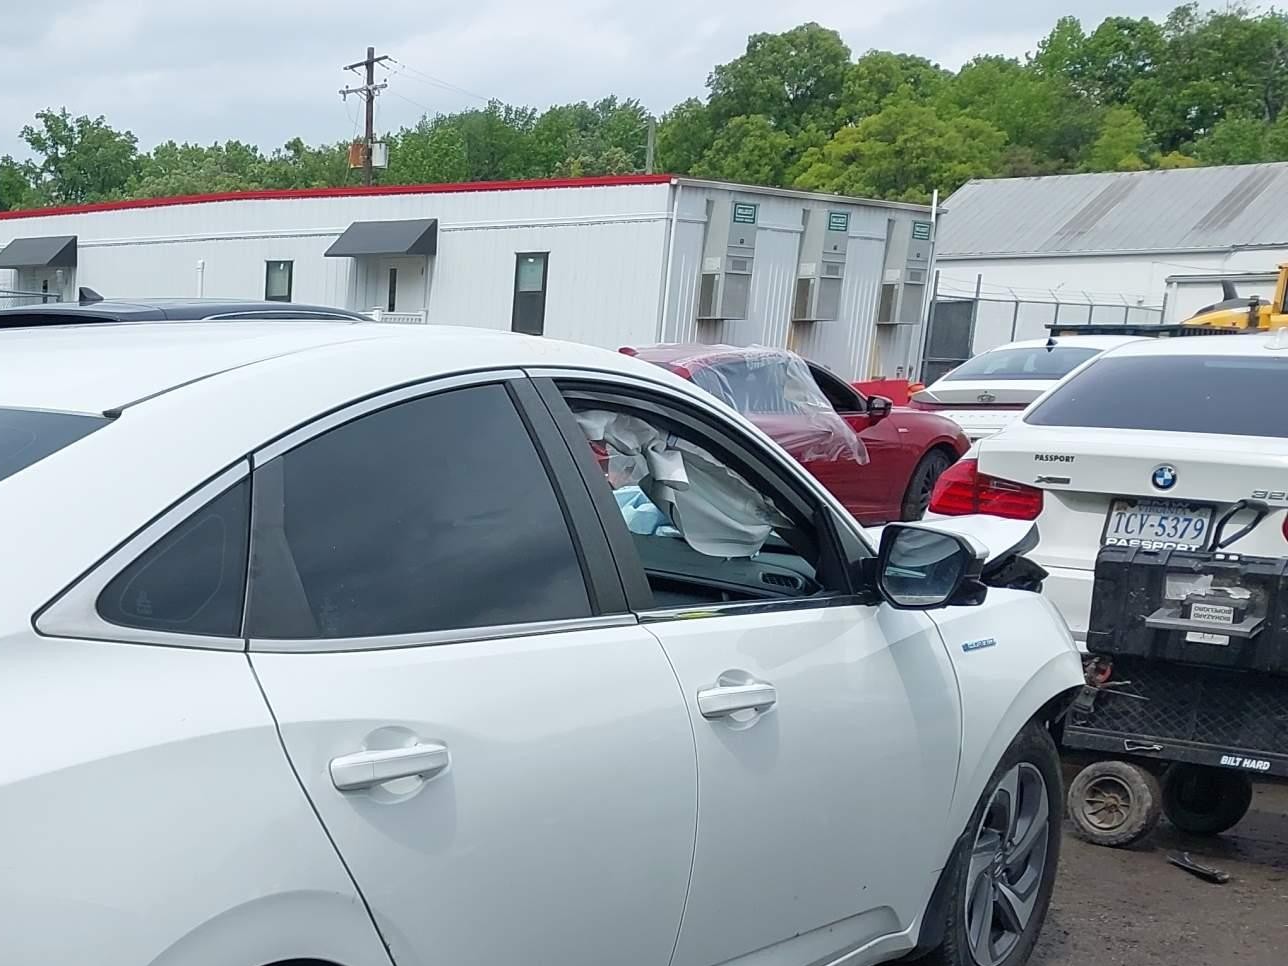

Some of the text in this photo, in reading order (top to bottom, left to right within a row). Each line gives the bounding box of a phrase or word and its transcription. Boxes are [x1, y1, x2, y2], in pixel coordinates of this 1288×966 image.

[1034, 454, 1075, 463] PASSPORT
[1251, 490, 1288, 501] 32
[1138, 505, 1188, 516] VIRGINIA
[1114, 512, 1205, 539] TCV-5379
[1105, 537, 1201, 552] PASSPORT
[1220, 755, 1271, 771] BILT HARD
